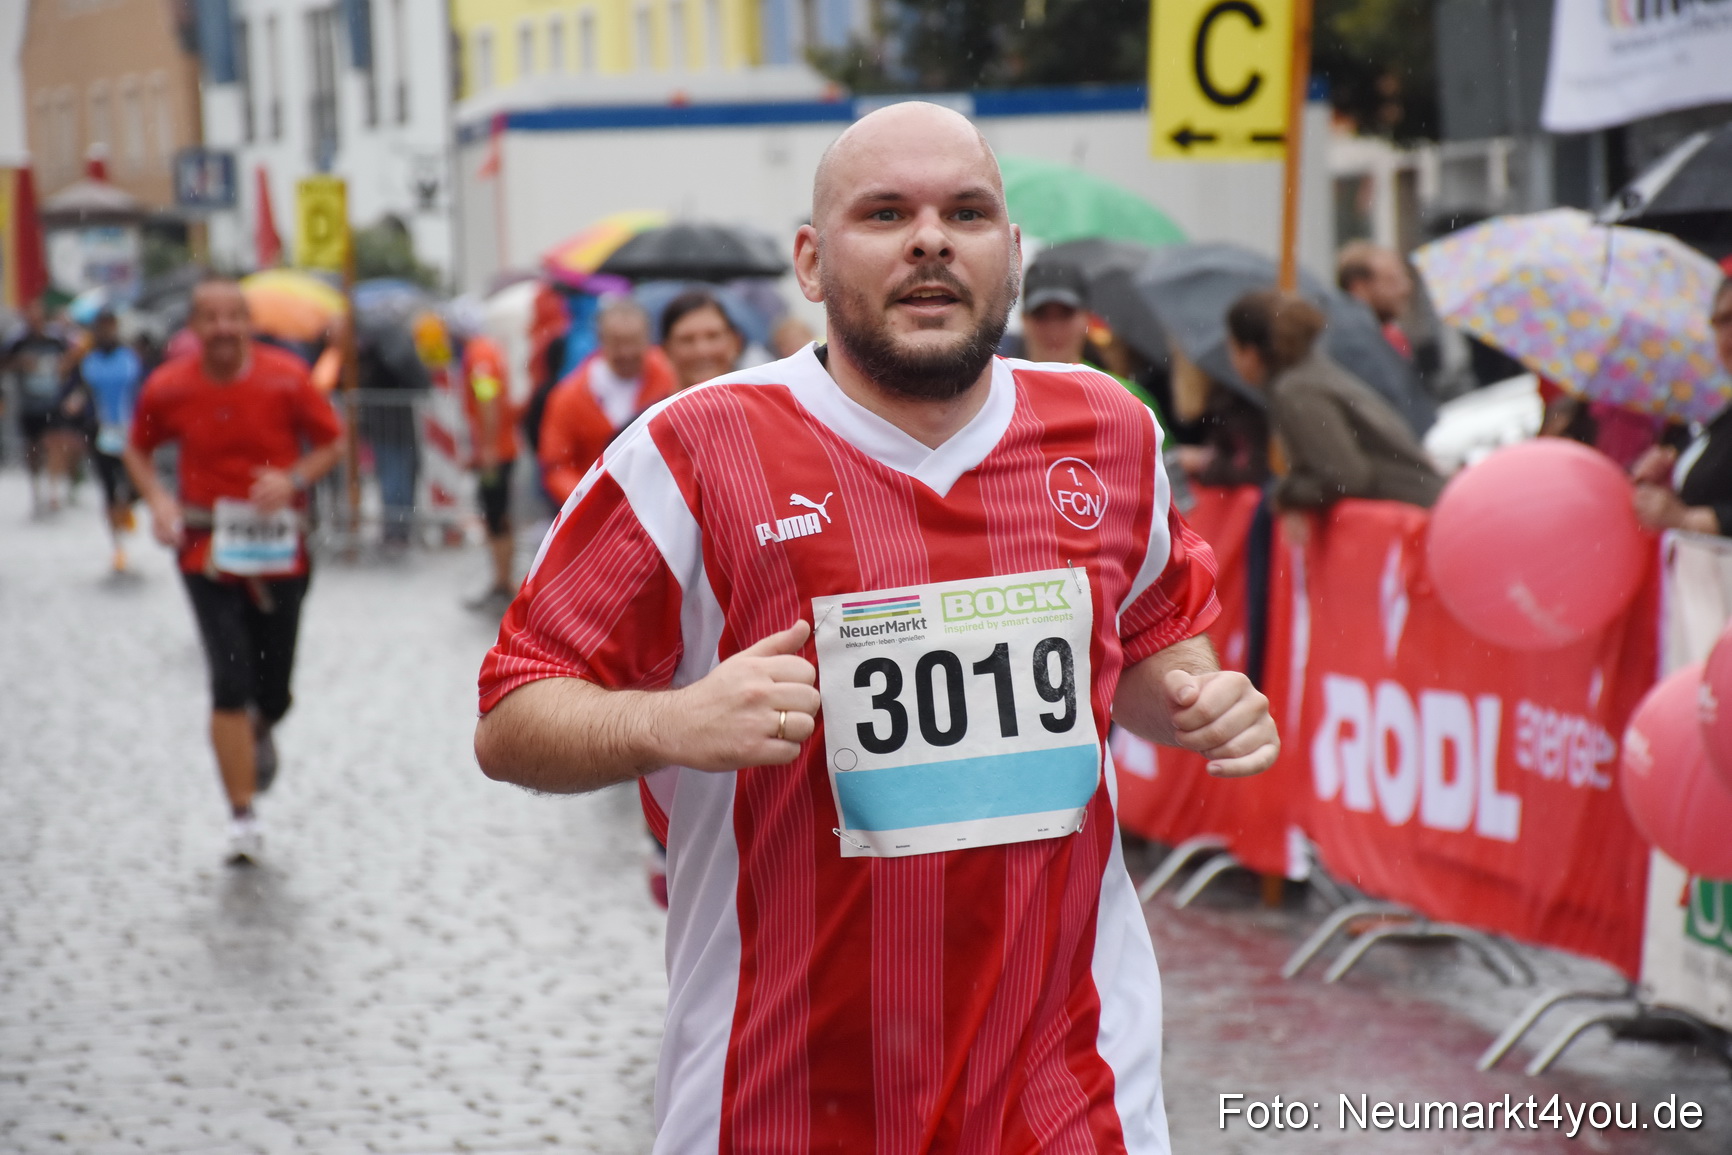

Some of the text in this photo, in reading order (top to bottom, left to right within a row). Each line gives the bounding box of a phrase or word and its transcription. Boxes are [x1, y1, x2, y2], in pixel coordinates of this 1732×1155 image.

[1194, 0, 1263, 106] C
[1057, 489, 1101, 519] FCN
[755, 512, 822, 547] PUMA
[942, 580, 1069, 621] BOCK
[839, 617, 928, 639] NeuerMarkt
[944, 613, 1074, 634] inspired by smart concepts
[853, 636, 1078, 755] 3019
